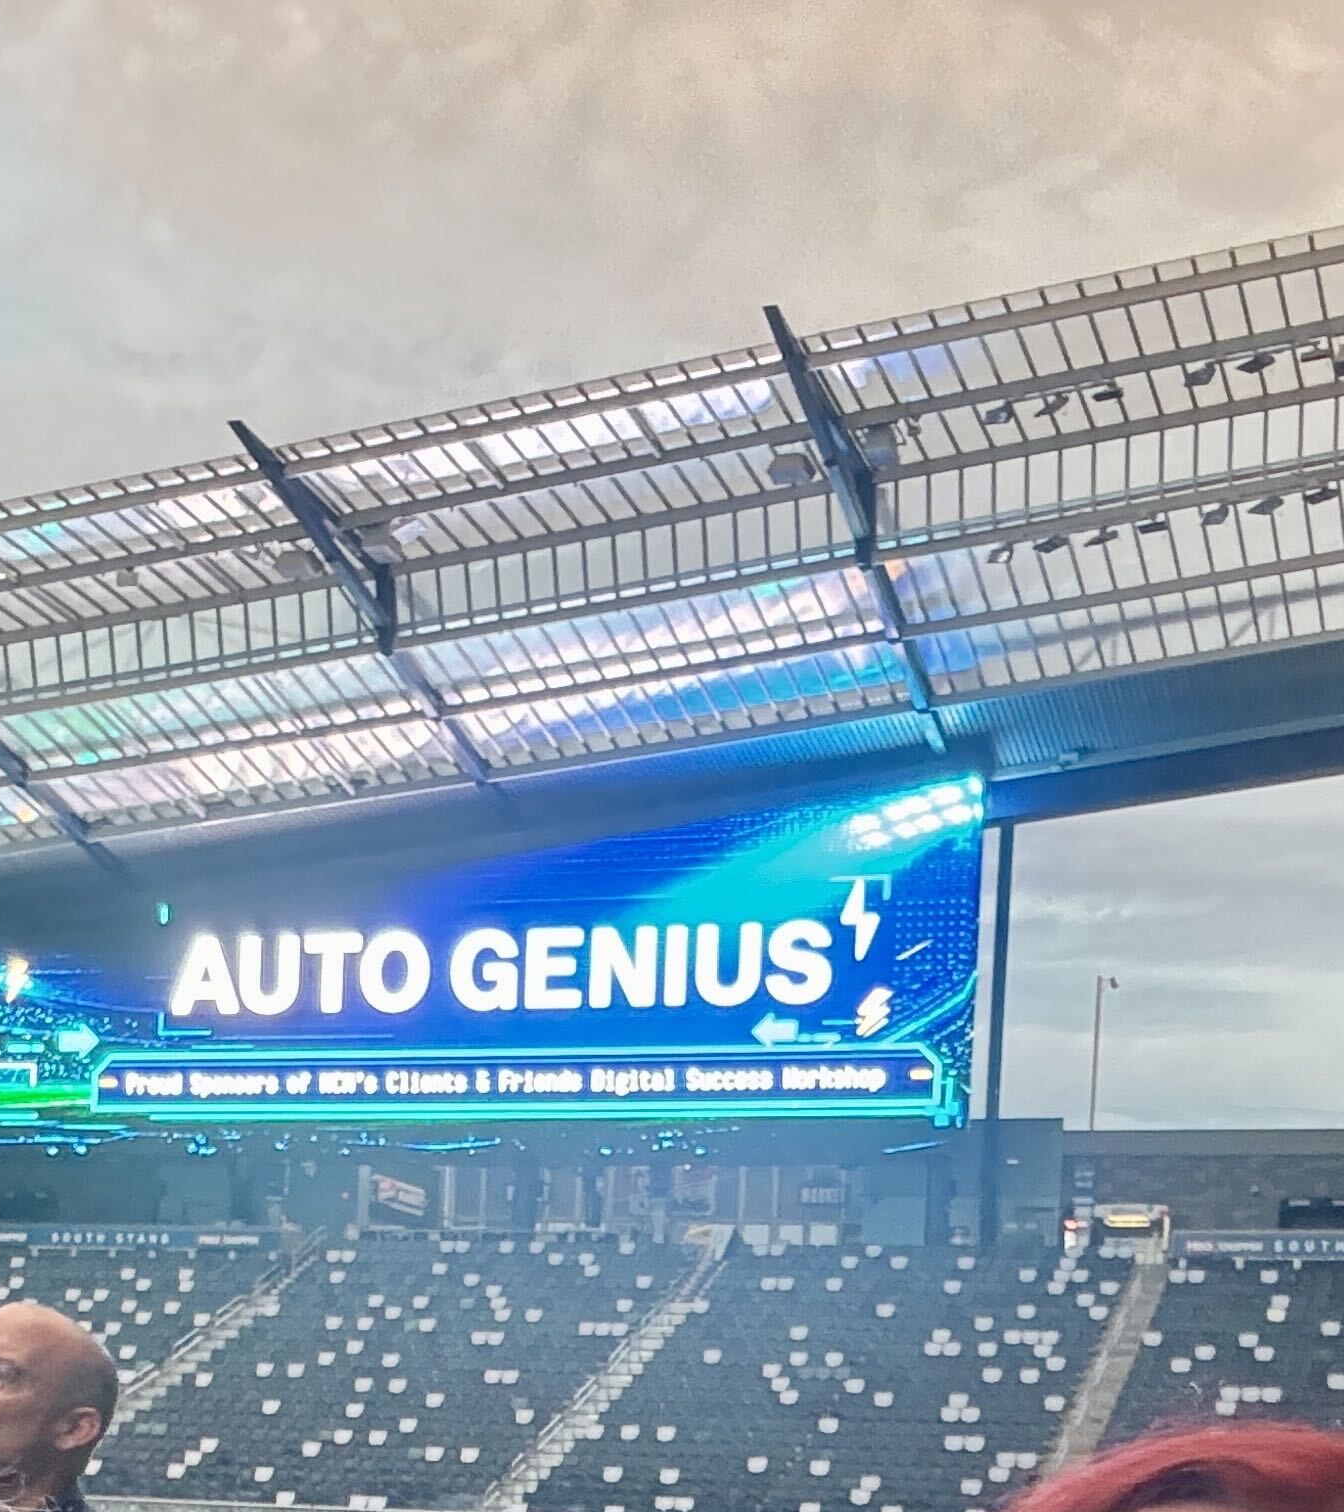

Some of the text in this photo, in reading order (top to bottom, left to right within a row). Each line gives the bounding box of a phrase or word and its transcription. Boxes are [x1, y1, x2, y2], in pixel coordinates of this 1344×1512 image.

[169, 920, 833, 1016] AUTO GENIUS
[125, 1071, 183, 1096] Proud
[189, 1072, 279, 1098] Sponsors
[286, 1072, 311, 1095] of
[385, 1070, 468, 1095] Clients
[476, 1069, 490, 1094] &
[498, 1068, 583, 1093] Friends
[590, 1067, 675, 1096] Digital
[685, 1067, 773, 1091] Success
[781, 1067, 886, 1092] Workshop
[52, 1232, 169, 1244] SOUTH STAND
